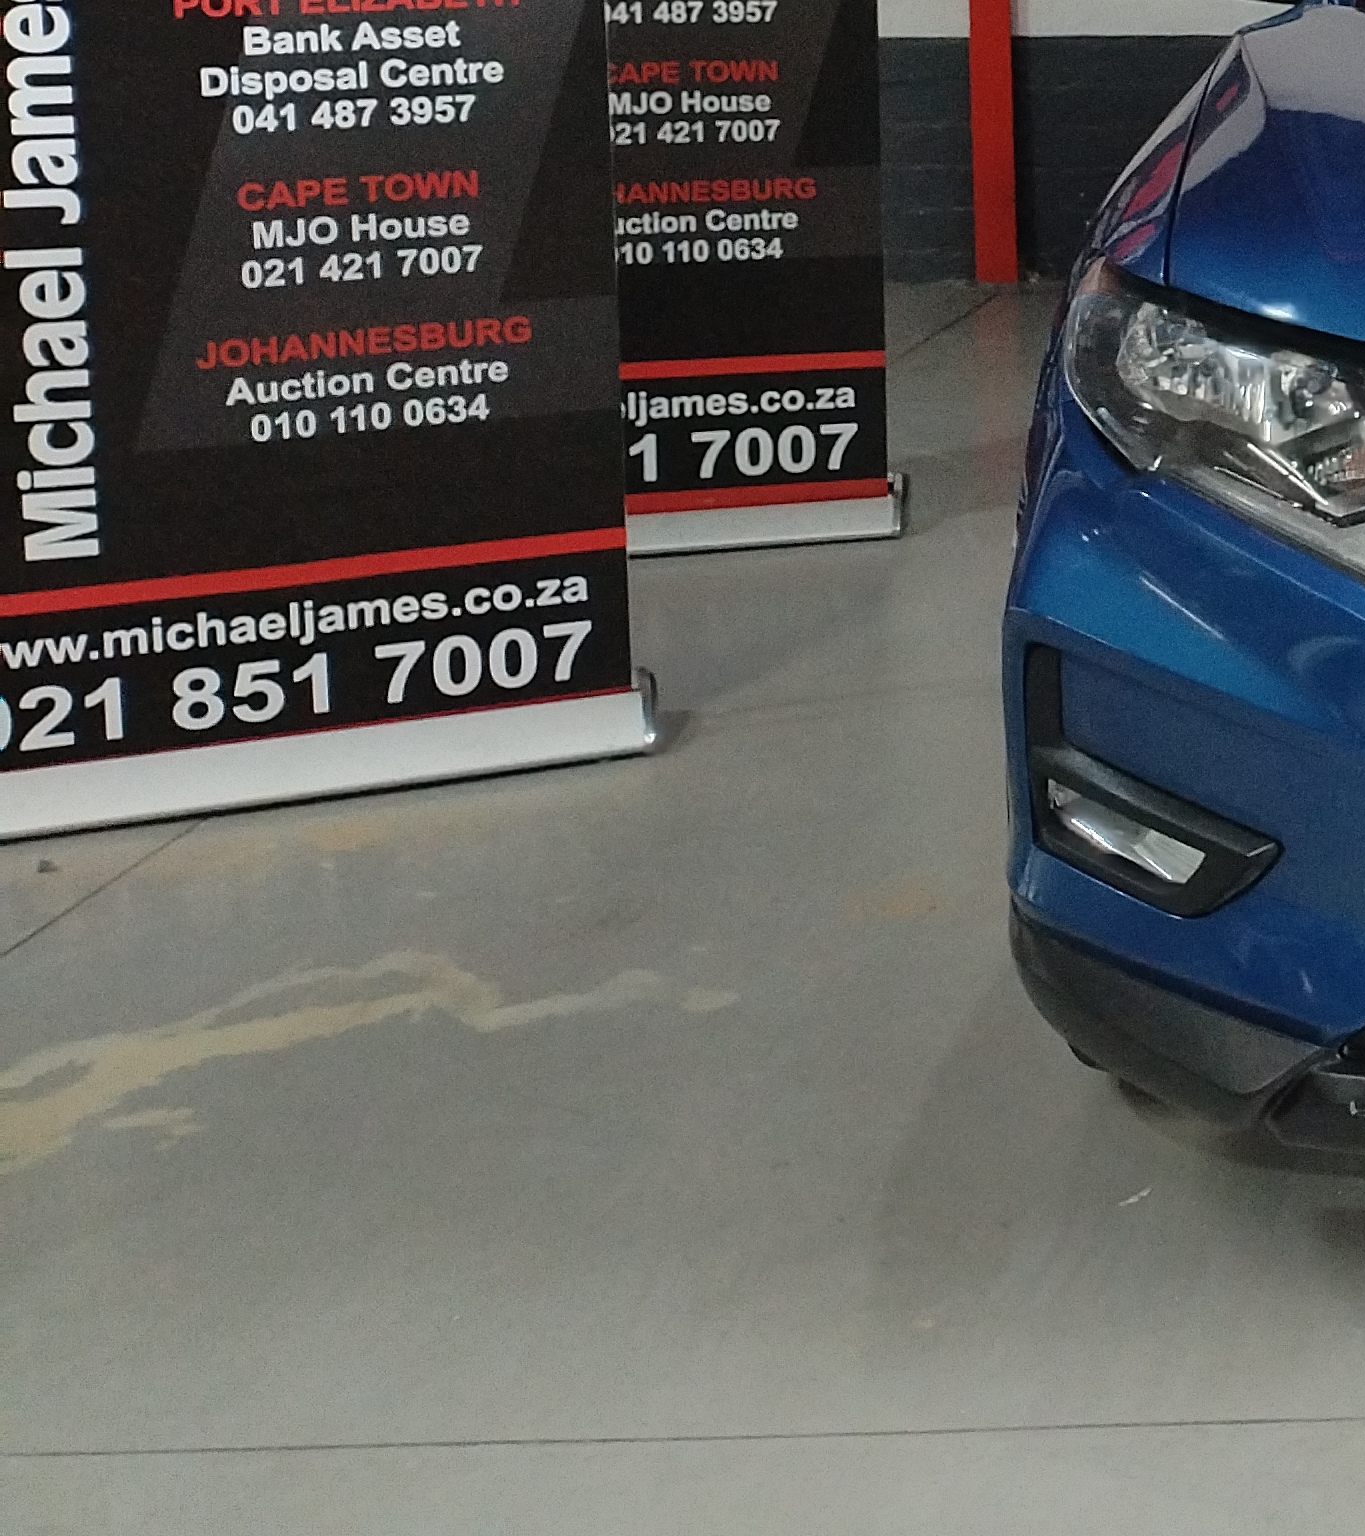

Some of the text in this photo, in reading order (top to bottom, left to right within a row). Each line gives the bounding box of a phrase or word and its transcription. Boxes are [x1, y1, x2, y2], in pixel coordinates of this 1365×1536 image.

[653, 0, 778, 24] 487 3957
[243, 20, 461, 56] Bank Asset
[200, 58, 505, 100] Disposal Centre
[690, 60, 779, 82] TOWN
[233, 94, 476, 134] 041 487 3957
[608, 90, 772, 115] MJO House
[657, 119, 781, 144] 421 7007
[237, 169, 480, 212] CAPE TOWN
[253, 213, 470, 249] MJO House
[705, 209, 799, 232] Centre
[241, 244, 484, 289] 021 421 7007
[662, 237, 784, 263] 110 0634
[196, 315, 533, 369] JOHANNESBURG
[226, 359, 509, 407] Auction Centre
[5, 249, 100, 561] Michael
[251, 394, 490, 442] 010 110 0634
[691, 422, 858, 479] 7007
[0, 575, 588, 669] ww.michaeljames.co.za
[0, 620, 592, 752] 21 851 7007
